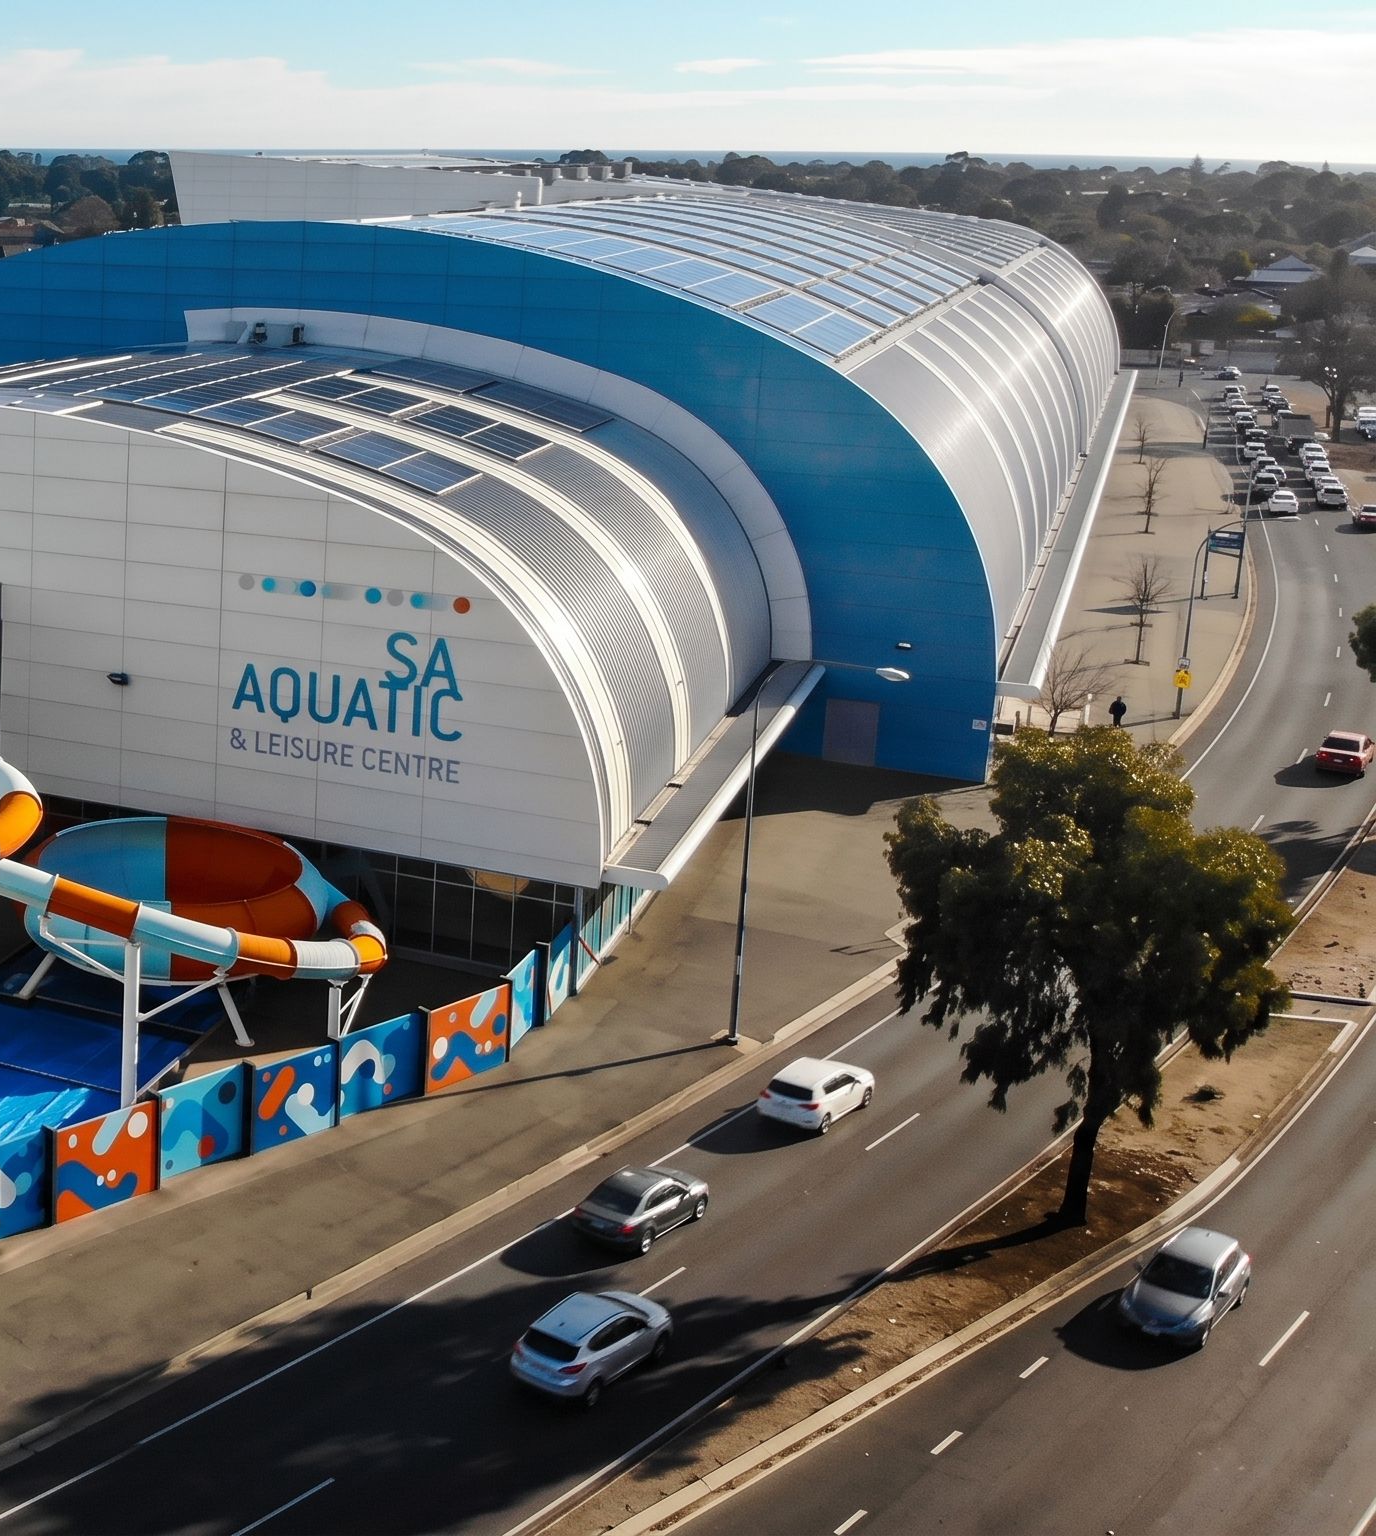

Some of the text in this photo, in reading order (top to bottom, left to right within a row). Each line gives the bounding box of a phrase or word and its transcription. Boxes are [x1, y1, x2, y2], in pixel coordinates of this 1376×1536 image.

[384, 632, 463, 701] SA
[232, 663, 463, 742] AQUATIC
[230, 727, 461, 784] & LEISURE CENTRE
